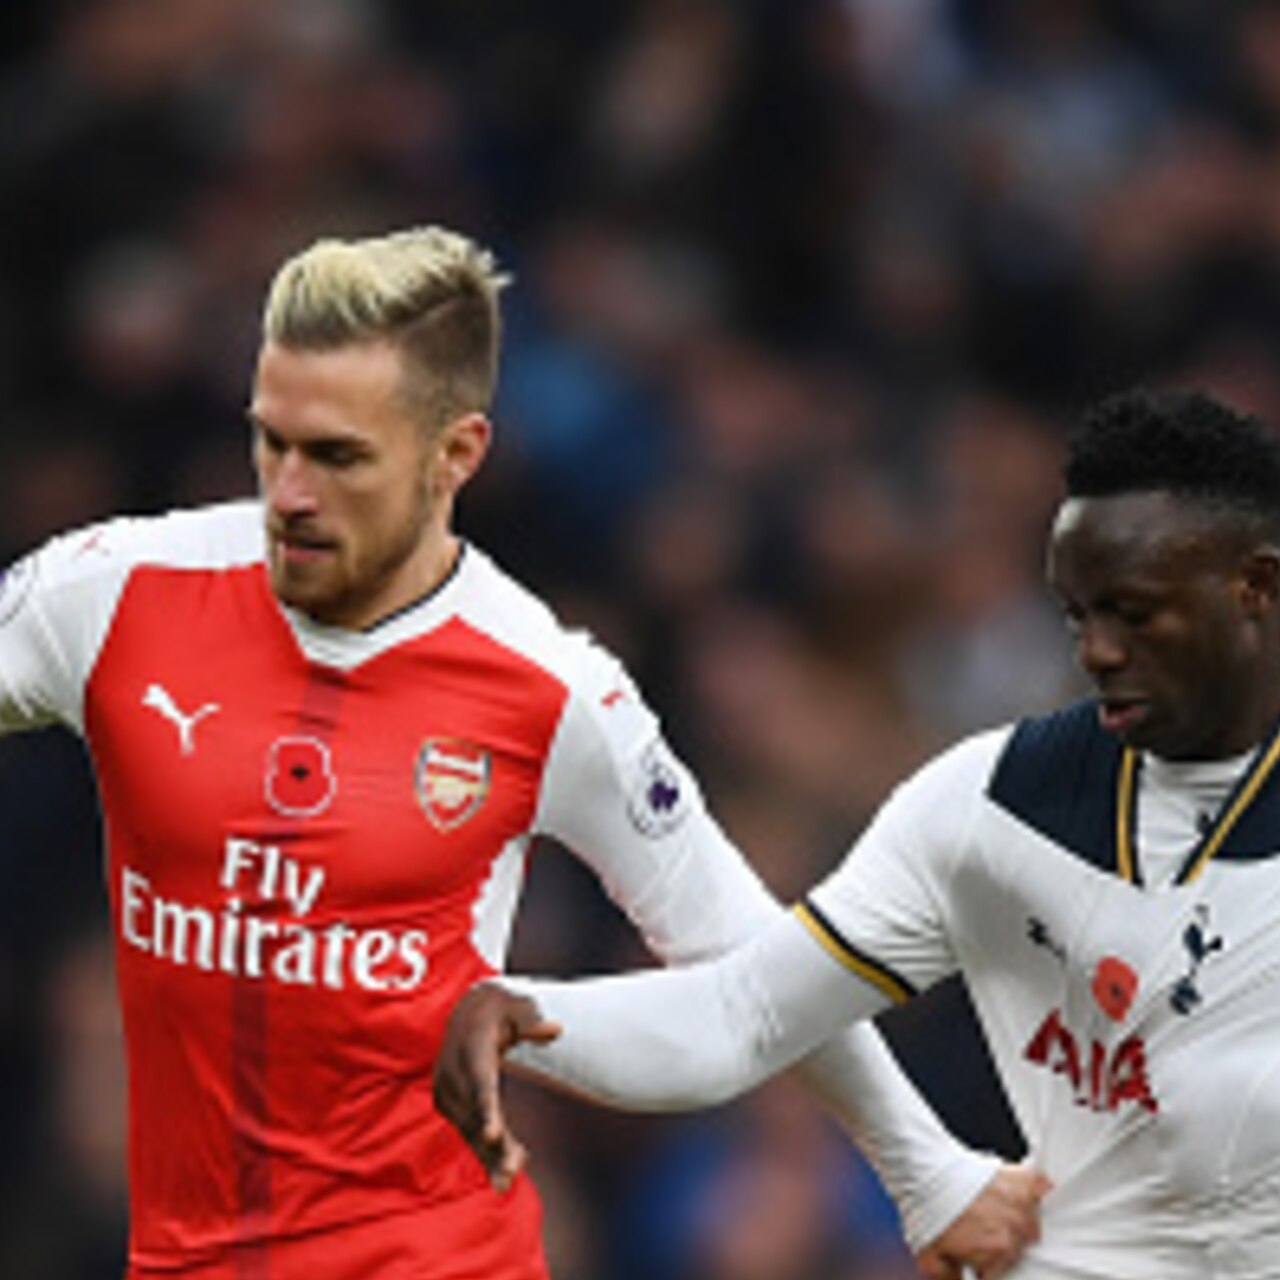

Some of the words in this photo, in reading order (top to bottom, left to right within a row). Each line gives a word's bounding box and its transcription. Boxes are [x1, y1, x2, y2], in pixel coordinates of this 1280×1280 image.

[122, 867, 429, 990] Emirates
[221, 837, 325, 917] Fly
[1024, 1008, 1158, 1113] AIA
